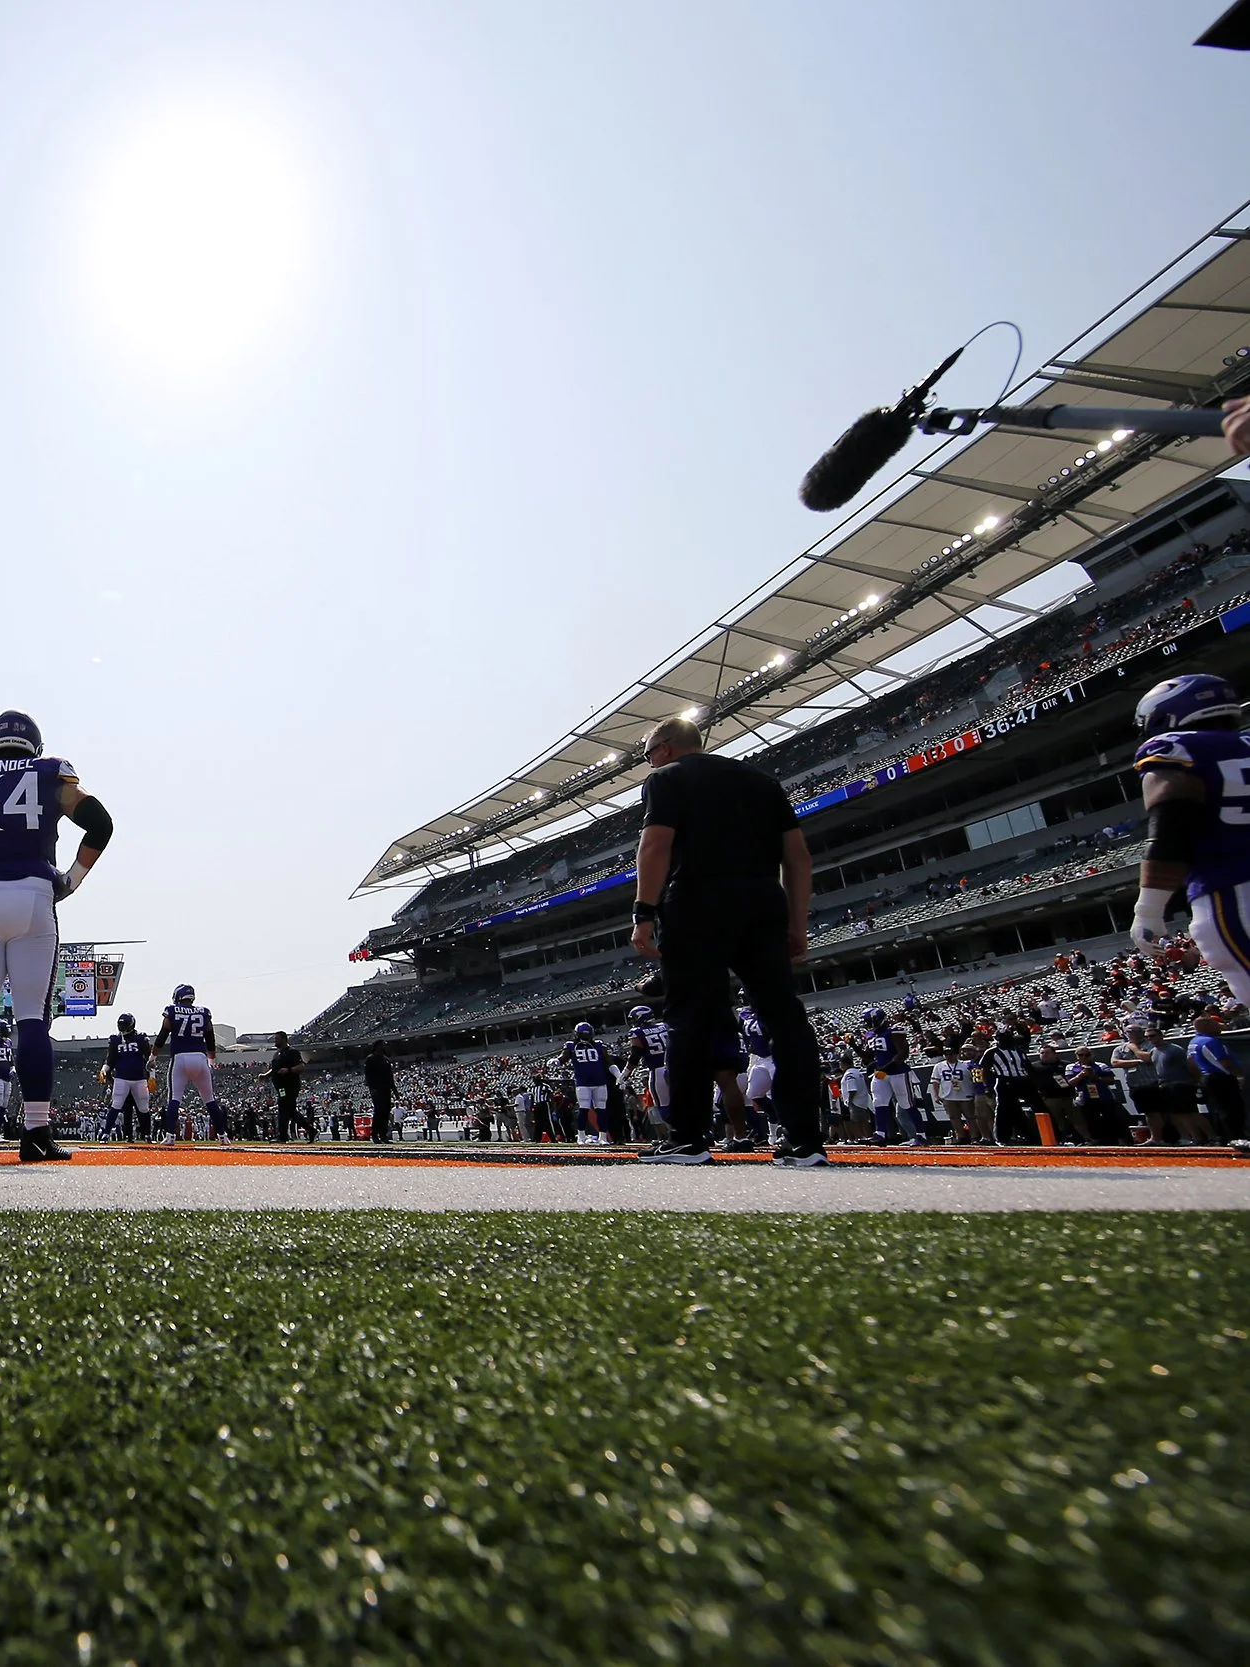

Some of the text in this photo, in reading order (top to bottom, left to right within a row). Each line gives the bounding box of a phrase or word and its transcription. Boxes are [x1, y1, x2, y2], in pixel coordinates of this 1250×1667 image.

[1162, 642, 1178, 656] ON
[984, 687, 1074, 739] 36:47 QTR 1
[953, 737, 965, 752] 0
[886, 766, 897, 780] 0
[174, 1014, 205, 1038] 72
[574, 1048, 599, 1063] 90
[941, 1069, 964, 1081] 69
